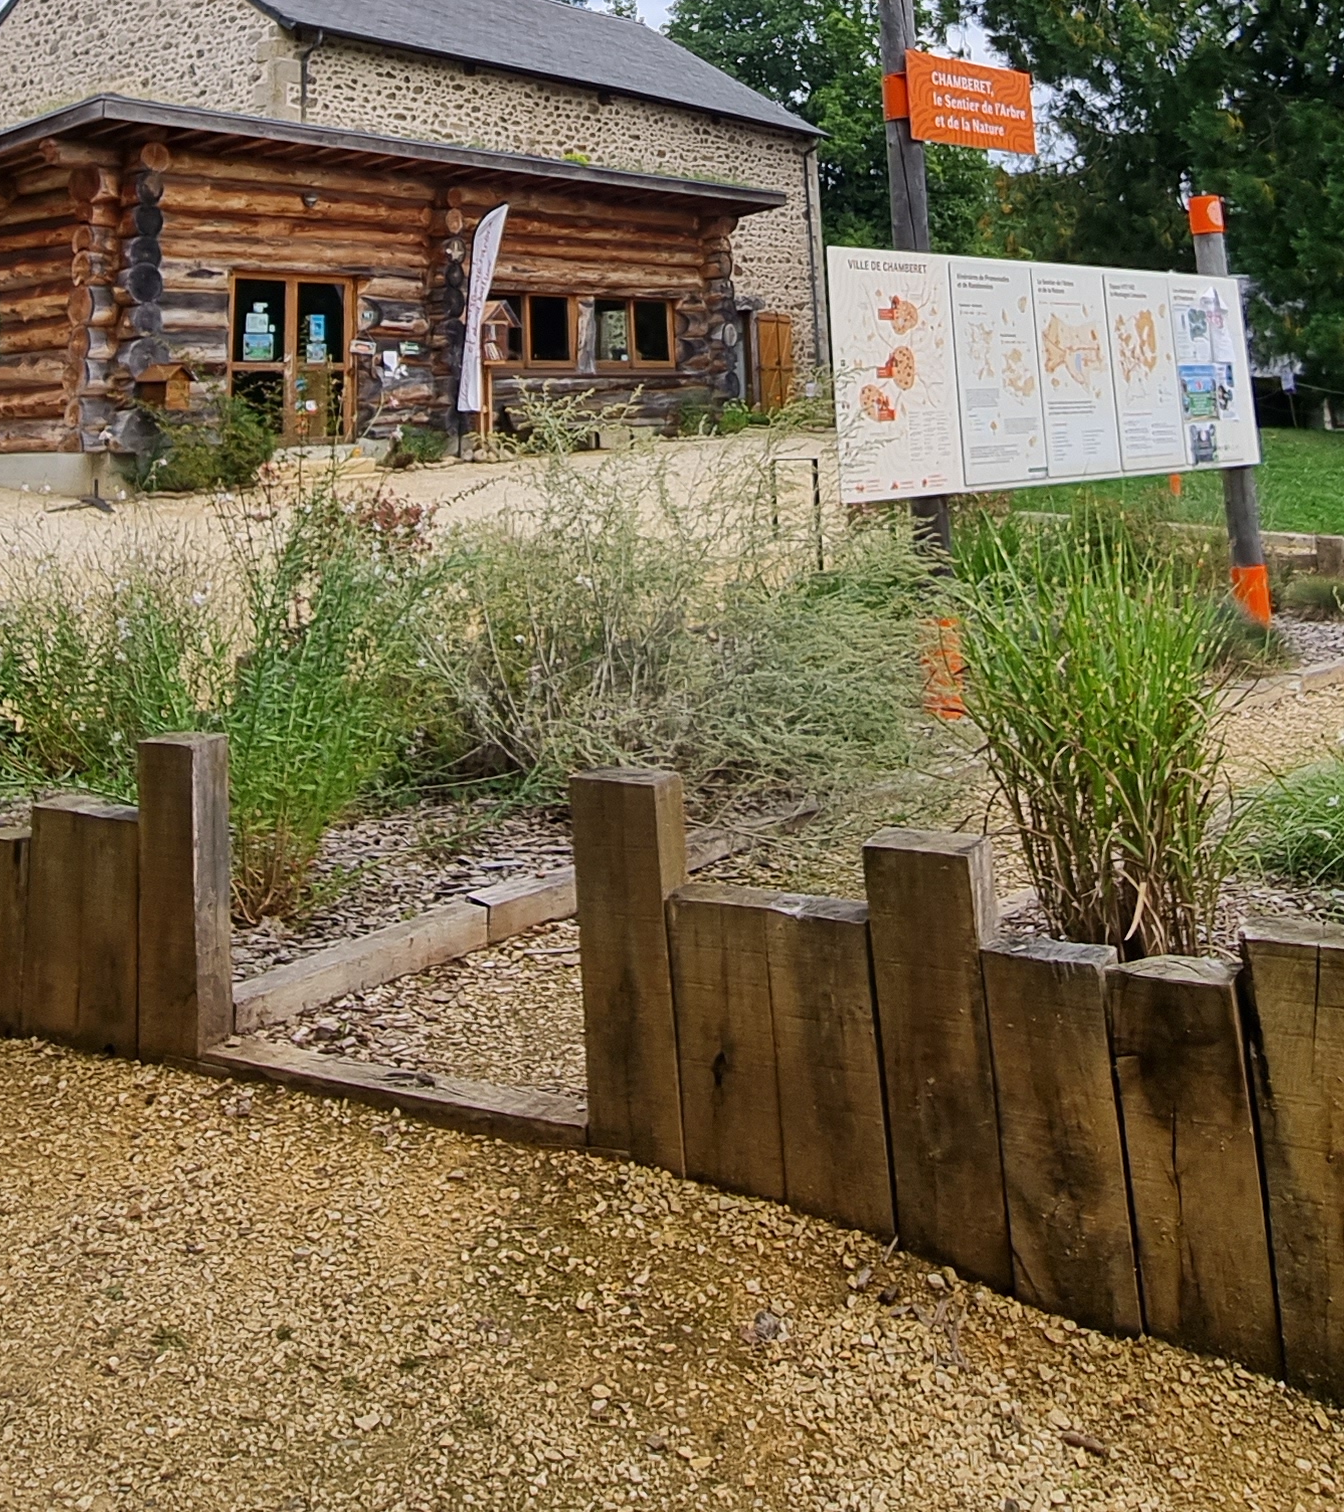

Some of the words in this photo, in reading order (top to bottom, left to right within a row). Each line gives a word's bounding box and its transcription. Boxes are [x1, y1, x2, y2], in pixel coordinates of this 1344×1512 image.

[931, 71, 994, 97] CHAMBERET,
[933, 91, 943, 107] le
[944, 94, 980, 113] Sentier
[981, 100, 994, 115] de
[995, 102, 1026, 121] l'Arbre
[935, 115, 945, 128] et
[947, 115, 960, 131] de
[961, 117, 971, 132] la
[972, 118, 1005, 137] Nature
[847, 259, 869, 271] VILLE
[870, 260, 882, 272] DE
[882, 261, 927, 274] CHAMBERET
